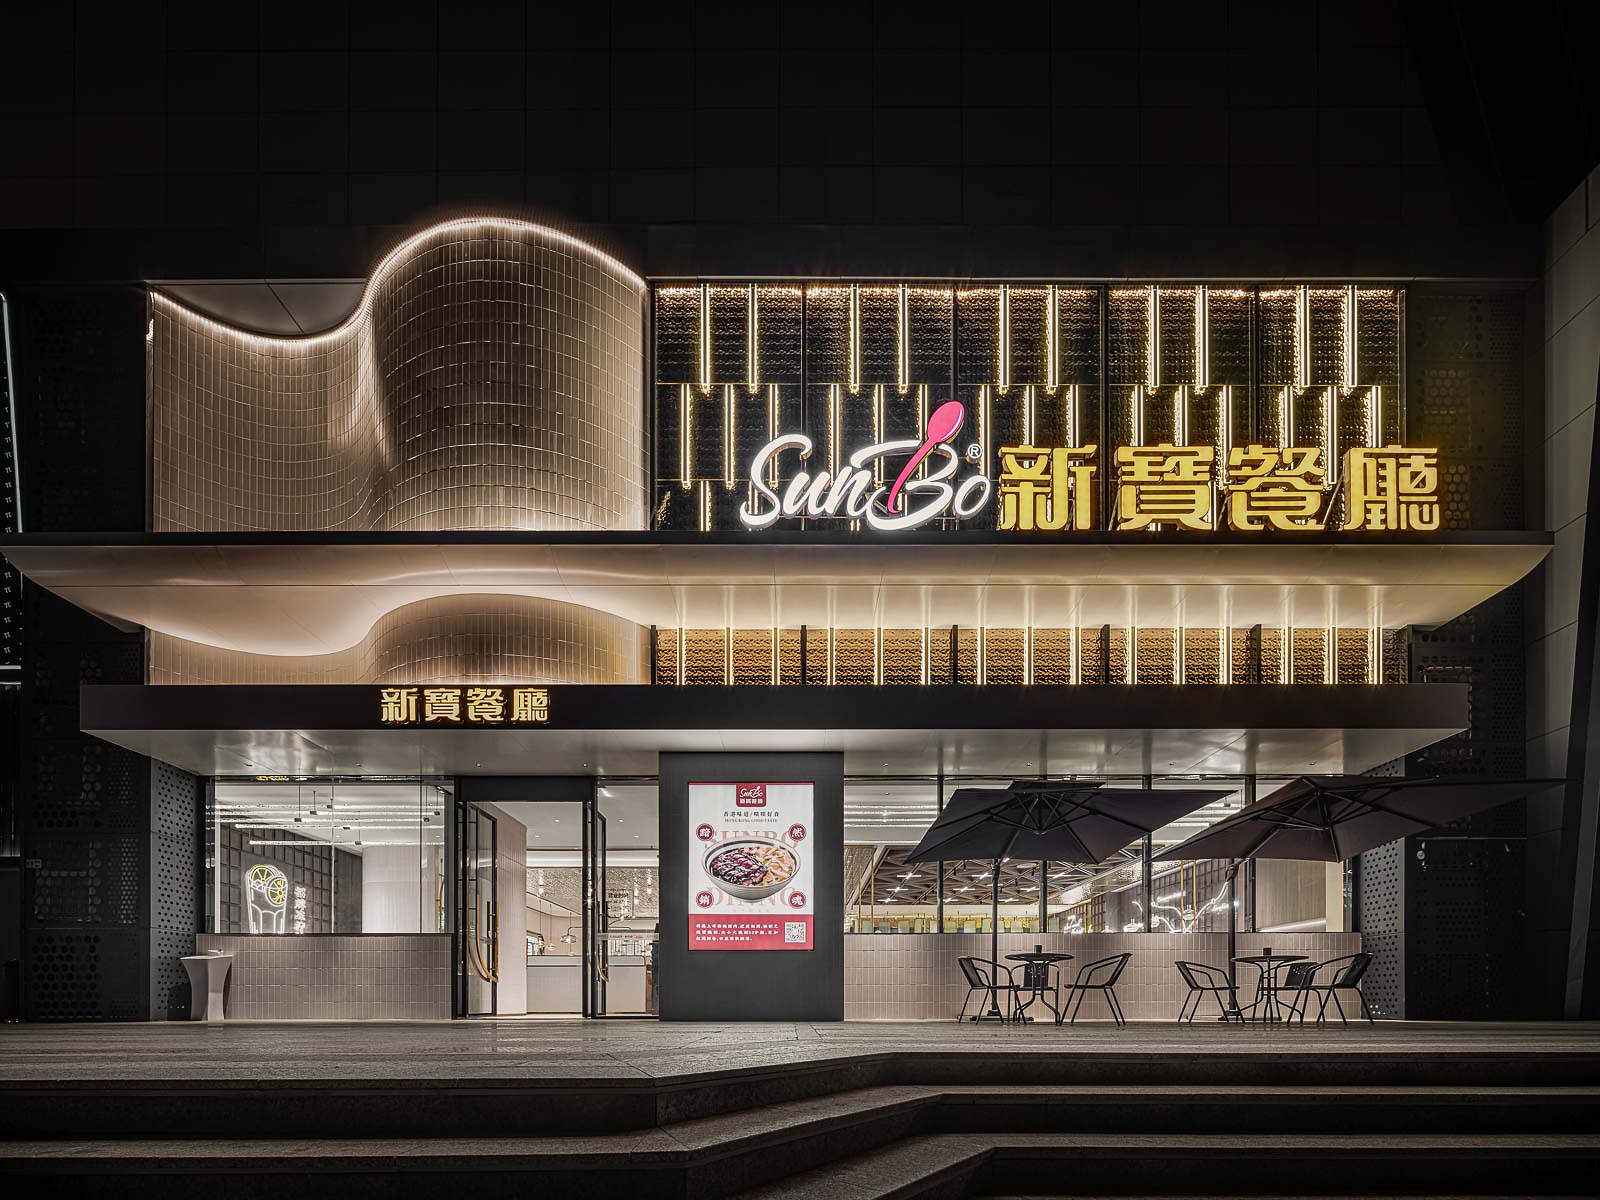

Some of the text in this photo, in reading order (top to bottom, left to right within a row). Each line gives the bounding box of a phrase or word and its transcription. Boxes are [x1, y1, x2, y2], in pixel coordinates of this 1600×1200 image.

[740, 430, 990, 530] SunBo
[999, 444, 1440, 531] 新寶餐廳
[380, 687, 548, 722] 新寶餐廳
